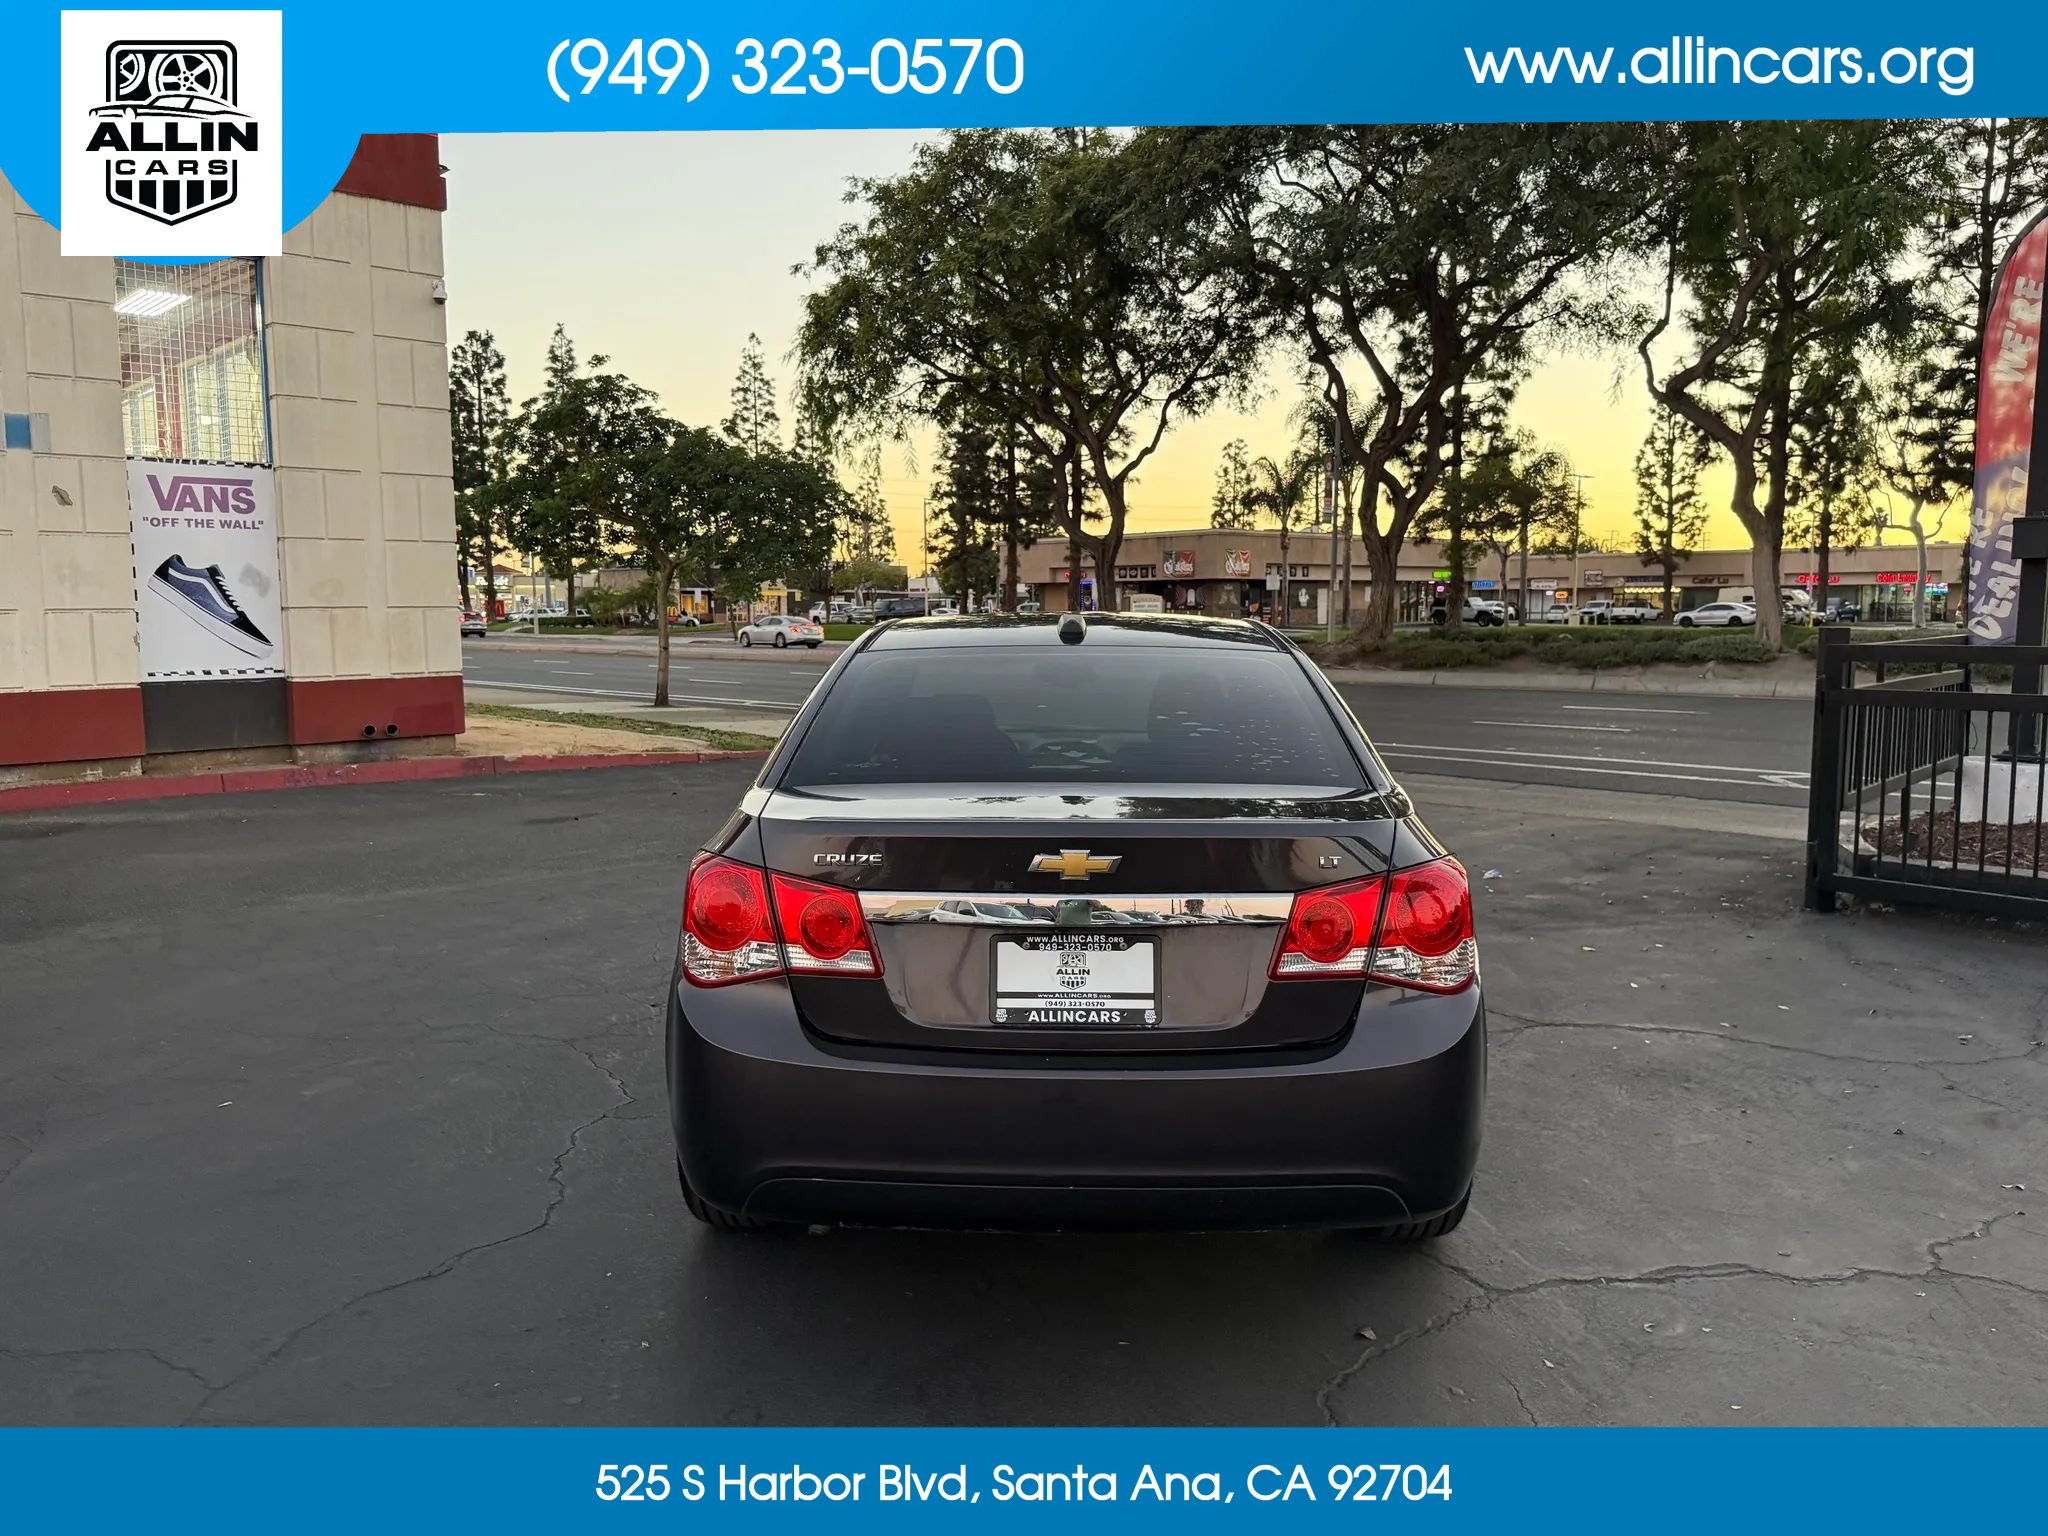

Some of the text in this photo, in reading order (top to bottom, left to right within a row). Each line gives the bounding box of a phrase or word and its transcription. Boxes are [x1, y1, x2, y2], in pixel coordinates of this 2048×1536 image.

[146, 474, 256, 515] VANS
[142, 516, 264, 530] "OFF THE WALL"
[1876, 573, 1896, 583] Coin
[813, 853, 883, 867] CRUZE
[1319, 856, 1342, 868] LT
[1039, 943, 1112, 951] 949-323-0570
[1056, 968, 1091, 976] ALLIN
[1045, 1000, 1067, 1008] (949)
[1028, 1010, 1122, 1023] ALLINCARS
